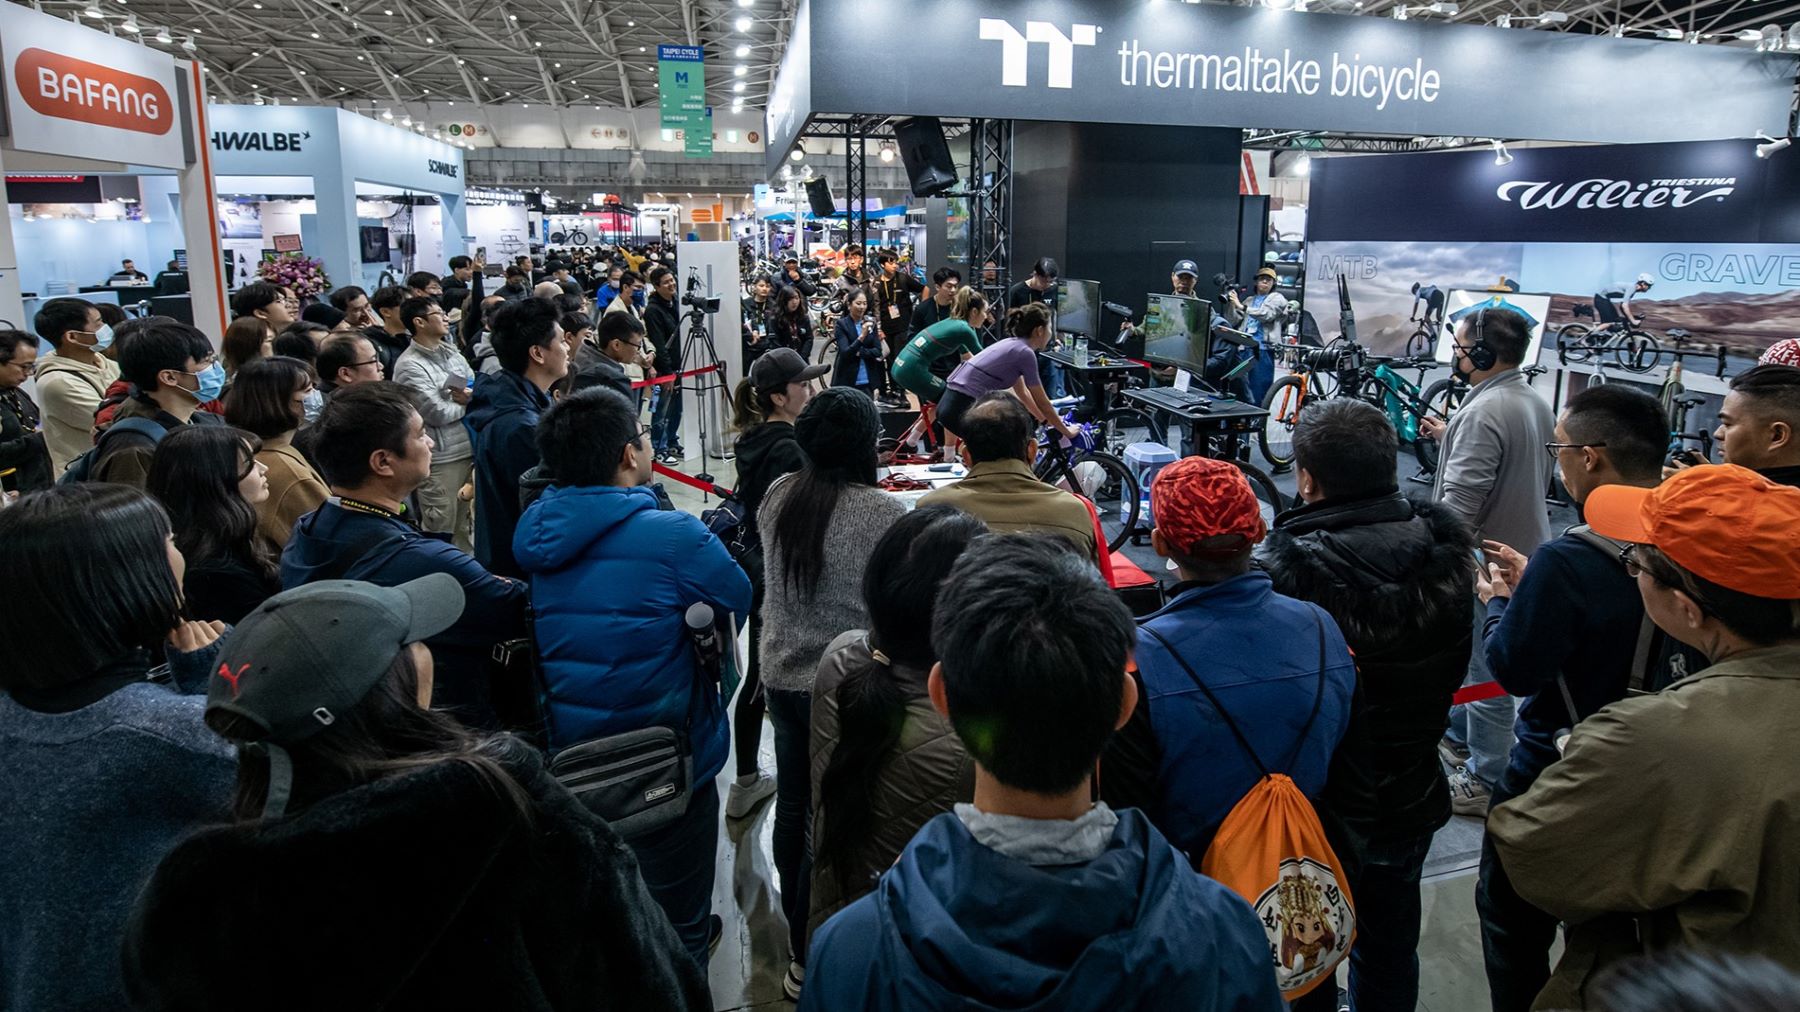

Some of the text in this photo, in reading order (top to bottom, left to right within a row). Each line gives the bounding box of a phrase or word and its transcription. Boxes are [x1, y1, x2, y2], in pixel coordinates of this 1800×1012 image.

[675, 72, 689, 83] M
[1118, 39, 1441, 111] thermaltake bicycle
[38, 66, 159, 121] BAFANG
[1496, 178, 1735, 210] Wilier
[1651, 178, 1737, 187] TRIESTINA
[1318, 254, 1378, 281] MTB
[1658, 252, 1800, 287] GRAVE
